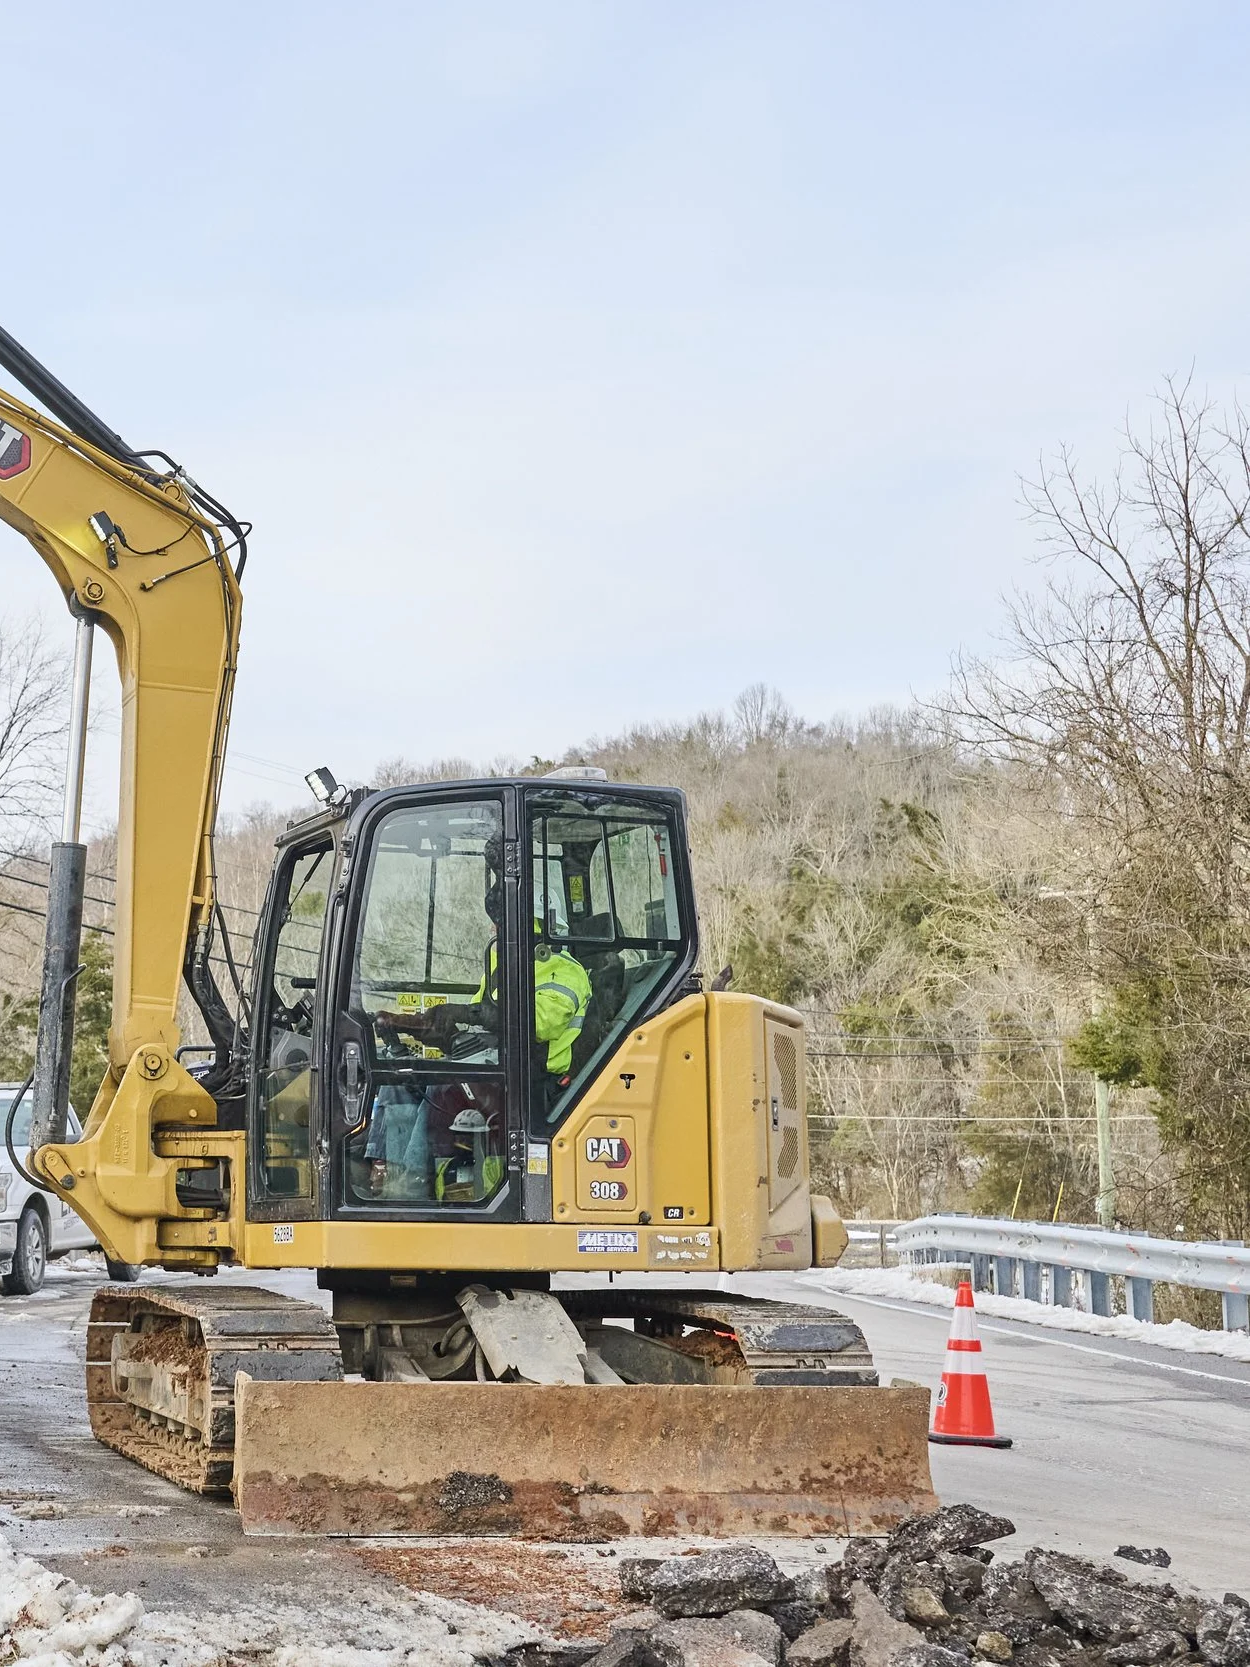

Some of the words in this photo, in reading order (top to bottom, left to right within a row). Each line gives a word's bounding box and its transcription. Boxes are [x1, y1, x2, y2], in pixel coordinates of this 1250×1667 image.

[586, 1138, 620, 1162] CAT
[590, 1181, 619, 1200] 308
[667, 1208, 680, 1218] CR
[580, 1232, 636, 1246] METRO
